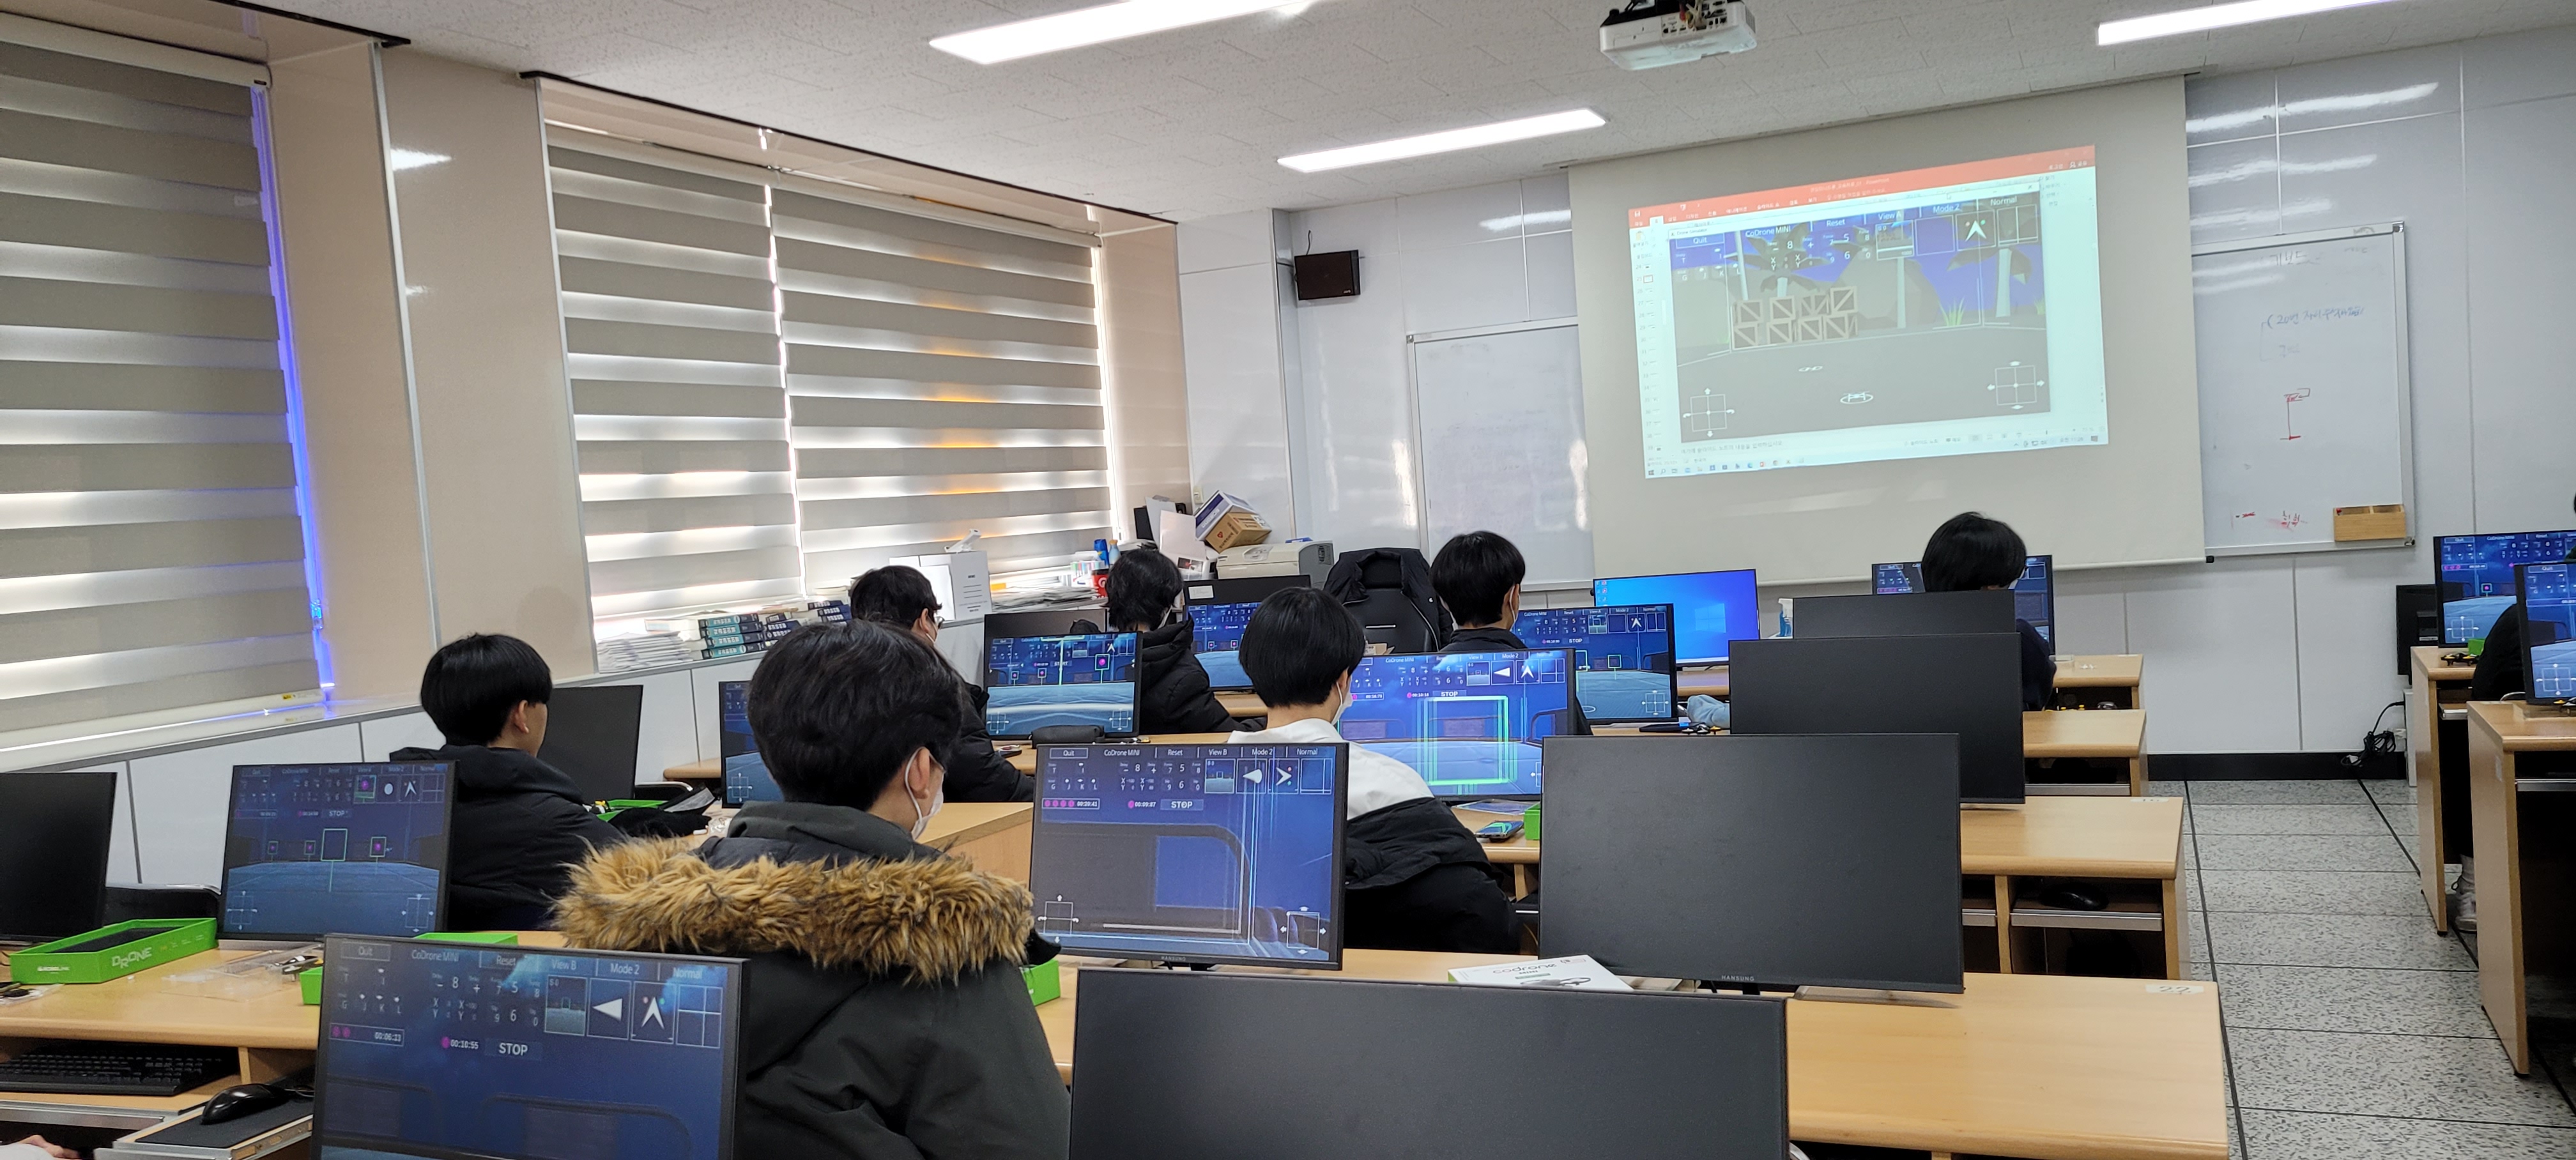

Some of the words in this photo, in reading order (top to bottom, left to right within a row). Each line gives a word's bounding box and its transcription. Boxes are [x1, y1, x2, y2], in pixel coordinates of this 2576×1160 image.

[1990, 196, 2018, 206] Normal
[1878, 212, 1896, 220] View
[1745, 227, 1775, 238] CoDrone
[1775, 225, 1791, 234] MINI
[1787, 241, 1793, 249] 8
[1843, 233, 1849, 241] 5
[1844, 251, 1850, 259] 6
[1179, 781, 1184, 789] 6
[358, 947, 373, 956] Quit
[411, 949, 442, 961] CoDrone
[443, 952, 459, 962] MINI
[112, 947, 153, 969] DRONE
[496, 955, 516, 966] Reset
[552, 959, 569, 970] View
[610, 963, 632, 975] Mode
[634, 965, 640, 975] 2
[1493, 963, 1558, 974] codrone
[673, 967, 703, 979] Normal
[452, 977, 459, 989] 8
[496, 986, 502, 995] 7
[512, 981, 518, 993] 5
[534, 989, 540, 998] 8
[433, 997, 438, 1007] X
[459, 1000, 464, 1009] X
[433, 1009, 438, 1018] Y
[457, 1011, 464, 1021] Y
[494, 1013, 500, 1022] 9
[510, 1009, 517, 1021] 6
[533, 1017, 538, 1026] 0
[499, 1042, 528, 1055] STOP
